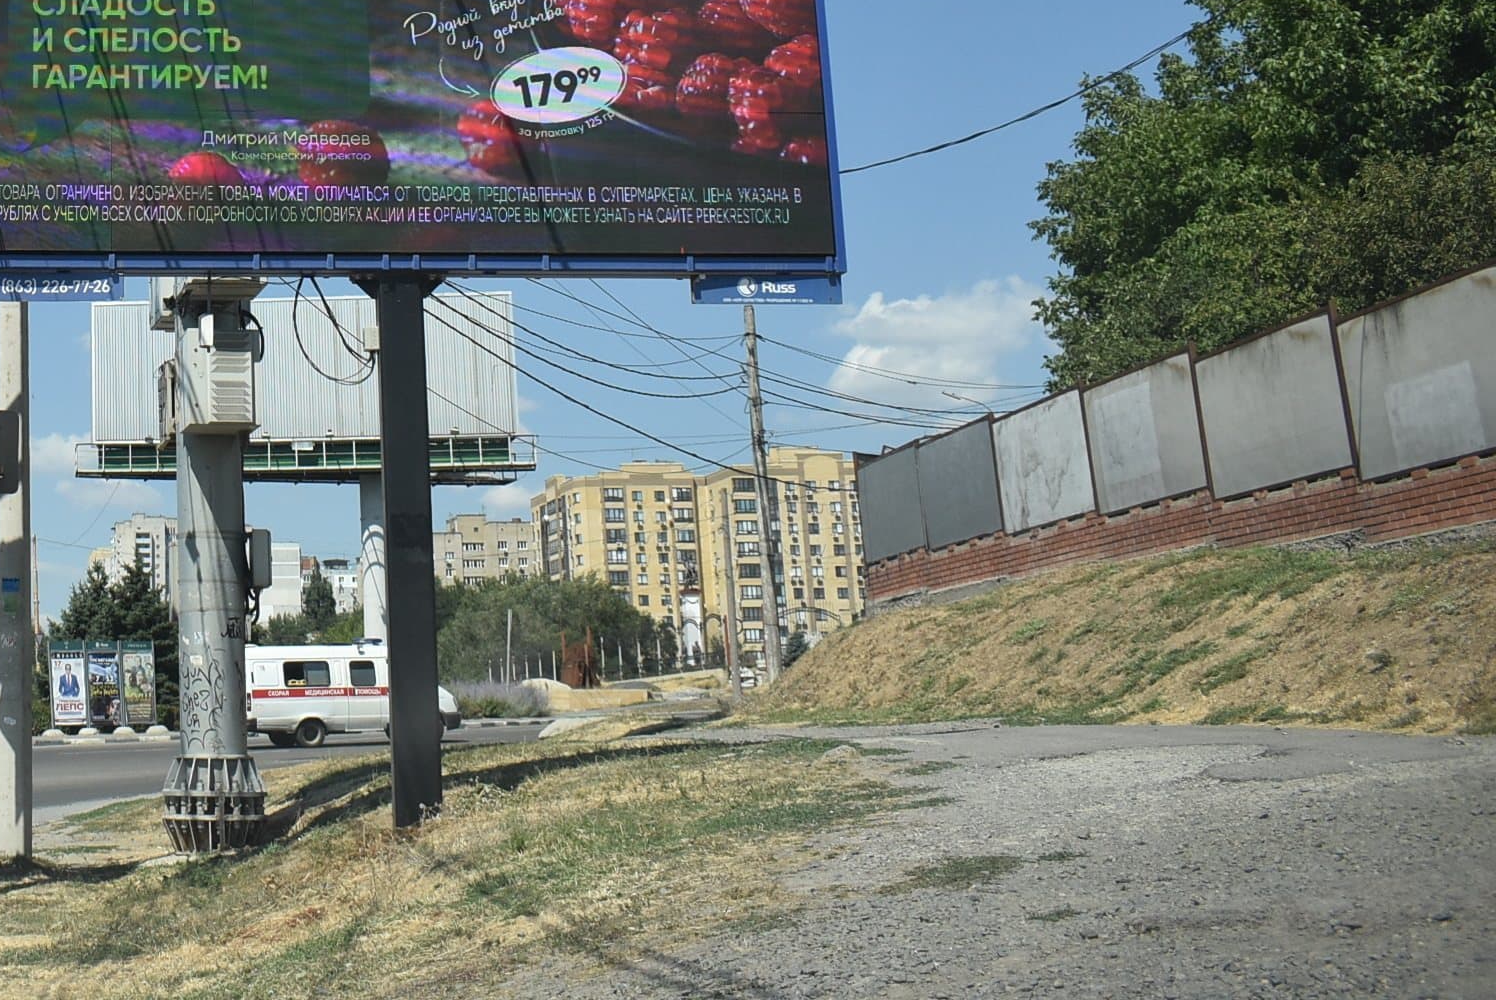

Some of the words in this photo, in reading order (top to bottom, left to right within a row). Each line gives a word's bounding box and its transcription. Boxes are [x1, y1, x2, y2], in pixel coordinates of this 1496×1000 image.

[403, 8, 482, 46] Родной
[32, 28, 53, 53] И
[64, 27, 242, 53] СПЕЛОСТЬ
[461, 36, 484, 61] из
[32, 64, 268, 90] ГАРАНТИРУЕМ!
[518, 127, 532, 138] за
[534, 124, 585, 140] упаковку
[584, 115, 603, 130] 125
[202, 131, 278, 147] Дмитрий
[283, 131, 371, 146] Медведев
[316, 152, 372, 163] директор
[45, 184, 125, 201] ОГРАНИЧЕНО.
[129, 184, 213, 201] ИЗОБРАЖЕНИЕ
[219, 185, 263, 201] ТОВАРА
[268, 185, 309, 201] МОЖЕТ
[315, 185, 390, 202] ОТЛИЧАТЬСЯ
[394, 186, 411, 202] ОТ
[478, 186, 583, 204] ПРЕДСТАВЛЕННЫХ
[588, 187, 596, 202] В
[703, 187, 732, 204] ЦЕНА
[737, 187, 789, 203] УКАЗАНА
[794, 187, 803, 204] В
[41, 205, 51, 221] С
[53, 204, 99, 222] УЧЕТОМ
[102, 205, 132, 221] ВСЕХ
[134, 205, 186, 223] СКИДОК.
[188, 206, 278, 224] ПОДРОБНОСТИ
[280, 206, 297, 222] ОБ
[301, 206, 363, 222] УСЛОВИЯХ
[408, 207, 416, 222] И
[418, 207, 431, 222] ЕЕ
[433, 207, 521, 223] ОРГАНИЗАТОРЕ
[544, 208, 591, 223] МОЖЕТЕ
[594, 208, 635, 223] УЗНАТЬ
[638, 208, 653, 223] НА
[656, 205, 694, 223] САЙТЕ
[1, 278, 37, 295] (863)
[41, 280, 111, 294] 226-77-26
[761, 281, 796, 294] Russ
[304, 689, 345, 697] МЕДИЦИНСКАЯ
[355, 688, 382, 696] ПОМОЩЬ
[56, 703, 84, 711] ЛЕПС
